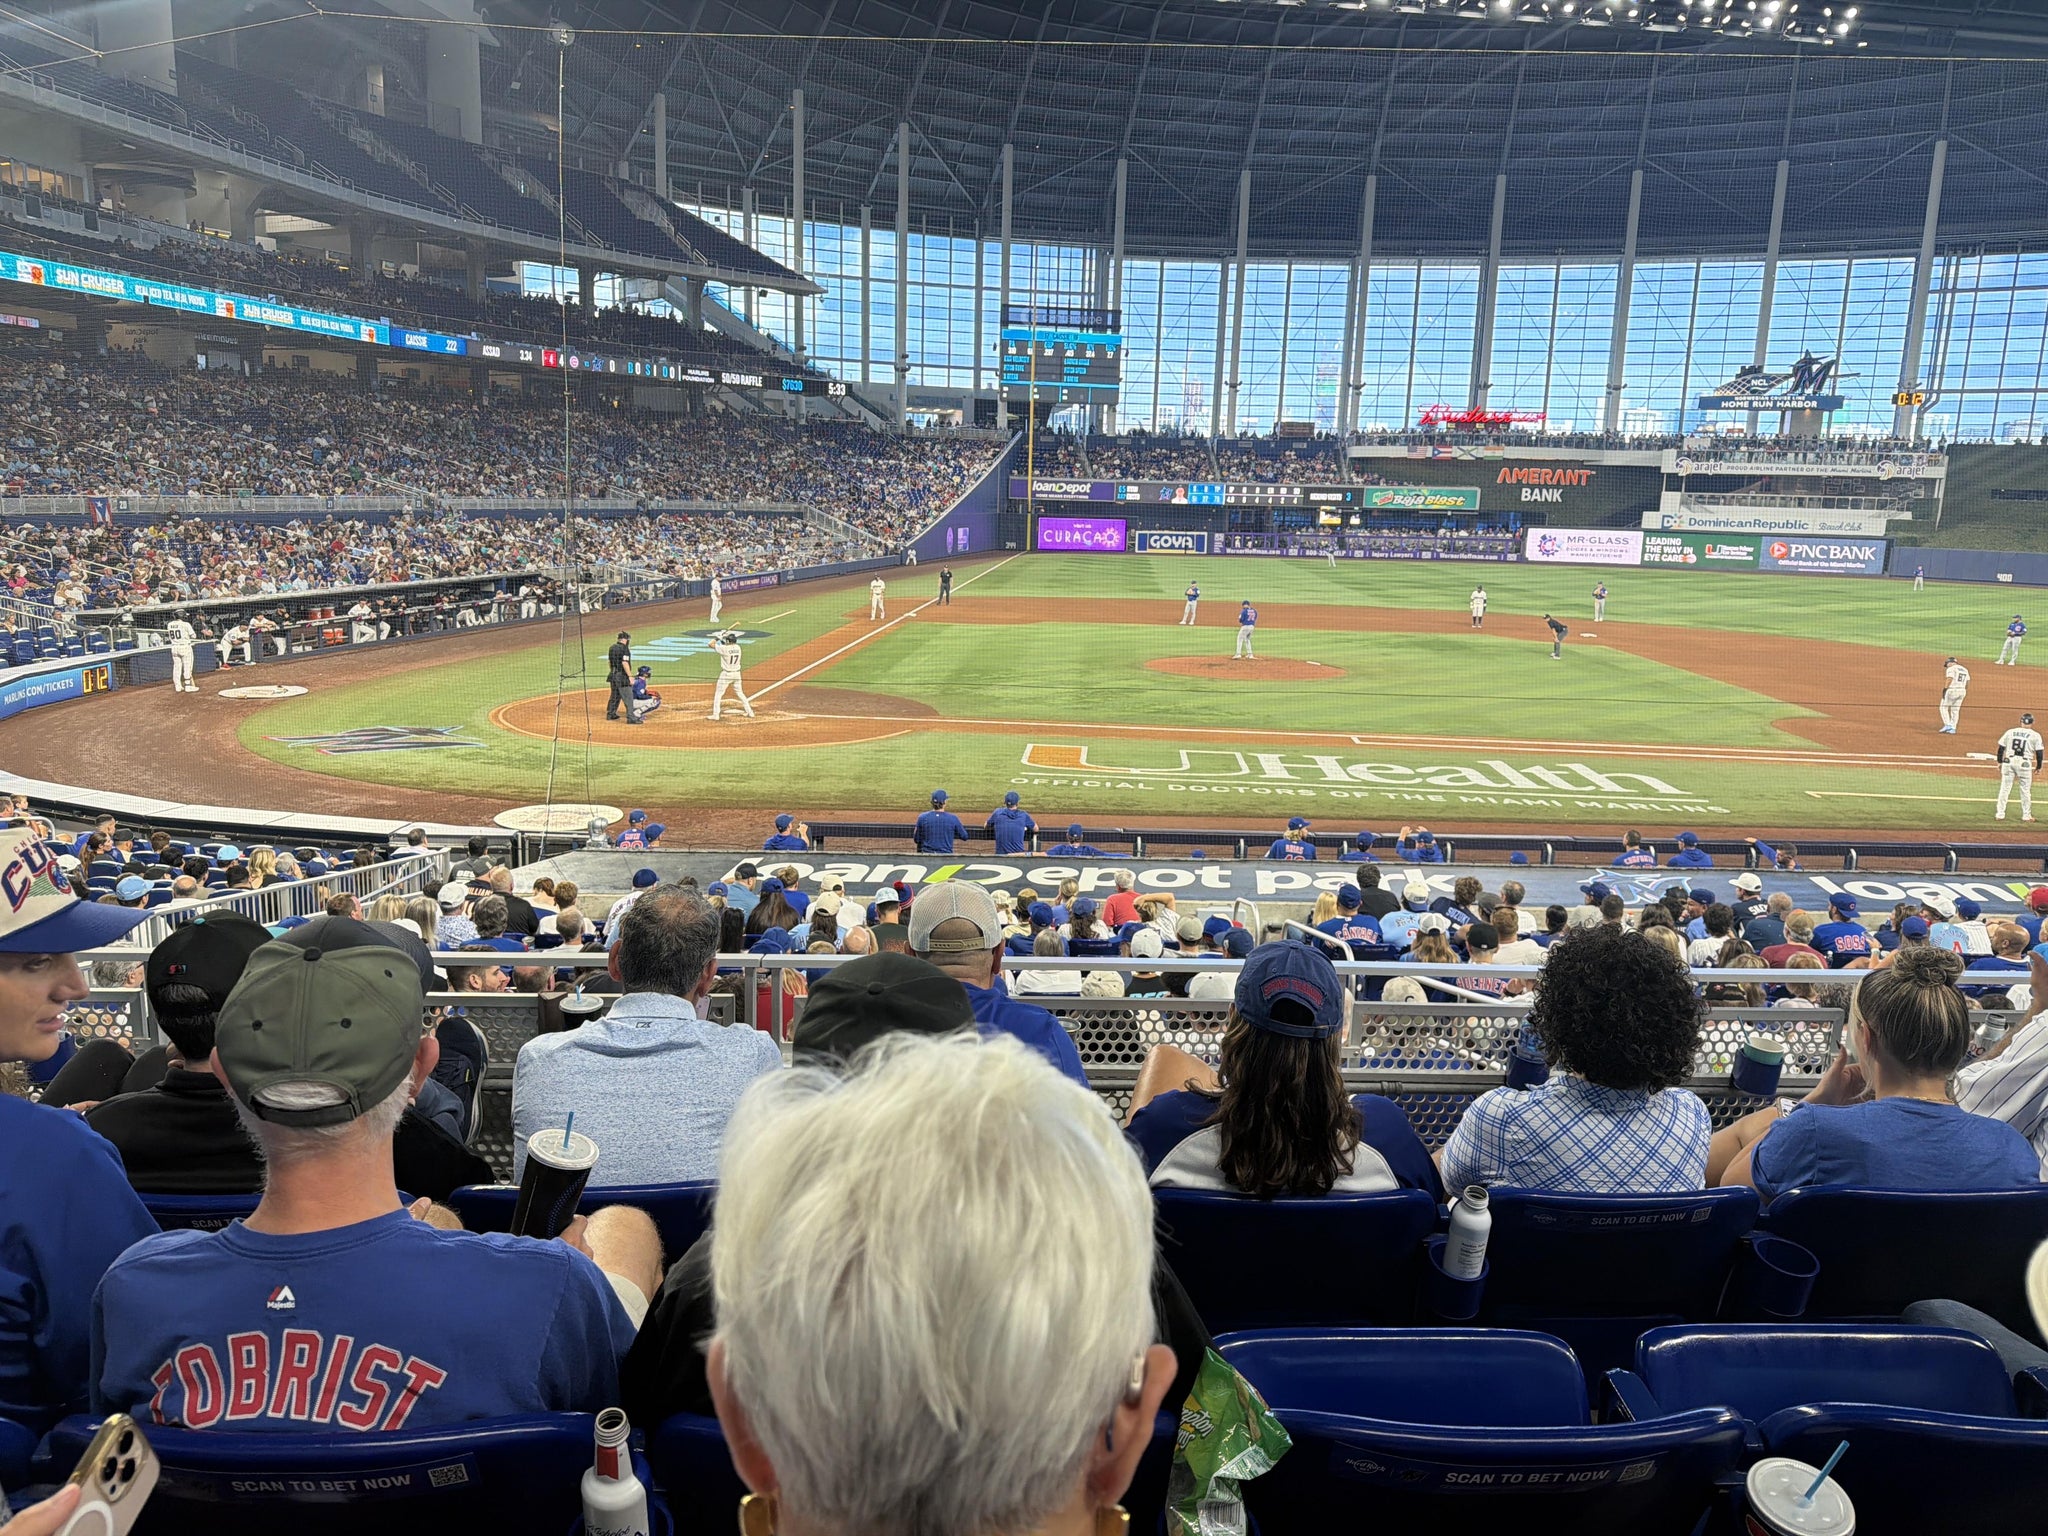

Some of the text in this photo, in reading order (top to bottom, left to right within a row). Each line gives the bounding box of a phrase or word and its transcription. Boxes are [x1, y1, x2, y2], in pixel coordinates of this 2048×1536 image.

[56, 268, 80, 287] SUN
[80, 273, 125, 295] CRUISER
[243, 303, 294, 324] SUN CRUISER
[482, 344, 501, 358] ASSAD
[721, 372, 763, 388] 50/50 RAFFLE
[1750, 378, 1769, 388] NCL
[828, 382, 846, 396] 5:33
[1721, 400, 1818, 409] HOME RUN HARBOR
[1896, 392, 1924, 406] 0:12
[1694, 460, 1724, 475] arajet
[1896, 465, 1926, 479] arajet
[1496, 467, 1591, 486] AMERANT
[1032, 480, 1092, 494] loanDepot
[1392, 494, 1425, 507] Baja
[1425, 495, 1466, 506] Blast
[1520, 487, 1563, 503] BANK
[1149, 534, 1194, 549] GOYA
[1645, 536, 1682, 546] LEADING
[1371, 551, 1389, 559] Injury
[1390, 552, 1414, 560] Lawyers
[1645, 545, 1694, 555] THE WAY IN
[1790, 543, 1876, 561] PNC BANK
[1644, 553, 1684, 563] EYE CARE
[729, 654, 739, 665] 17
[1010, 777, 1732, 815] OFFICIAL DOCTORS OF THE MIAMI MARLINS
[1255, 867, 1456, 895] park
[1445, 906, 1471, 925] SUZUKI
[191, 1218, 222, 1229] SCAN
[1591, 1211, 1686, 1226] SCAN TO BET NOW
[266, 1300, 296, 1311] Majestic
[231, 1474, 411, 1493] SCAN TO BET NOW
[1445, 1469, 1611, 1485] SCAN TO BET NOW
